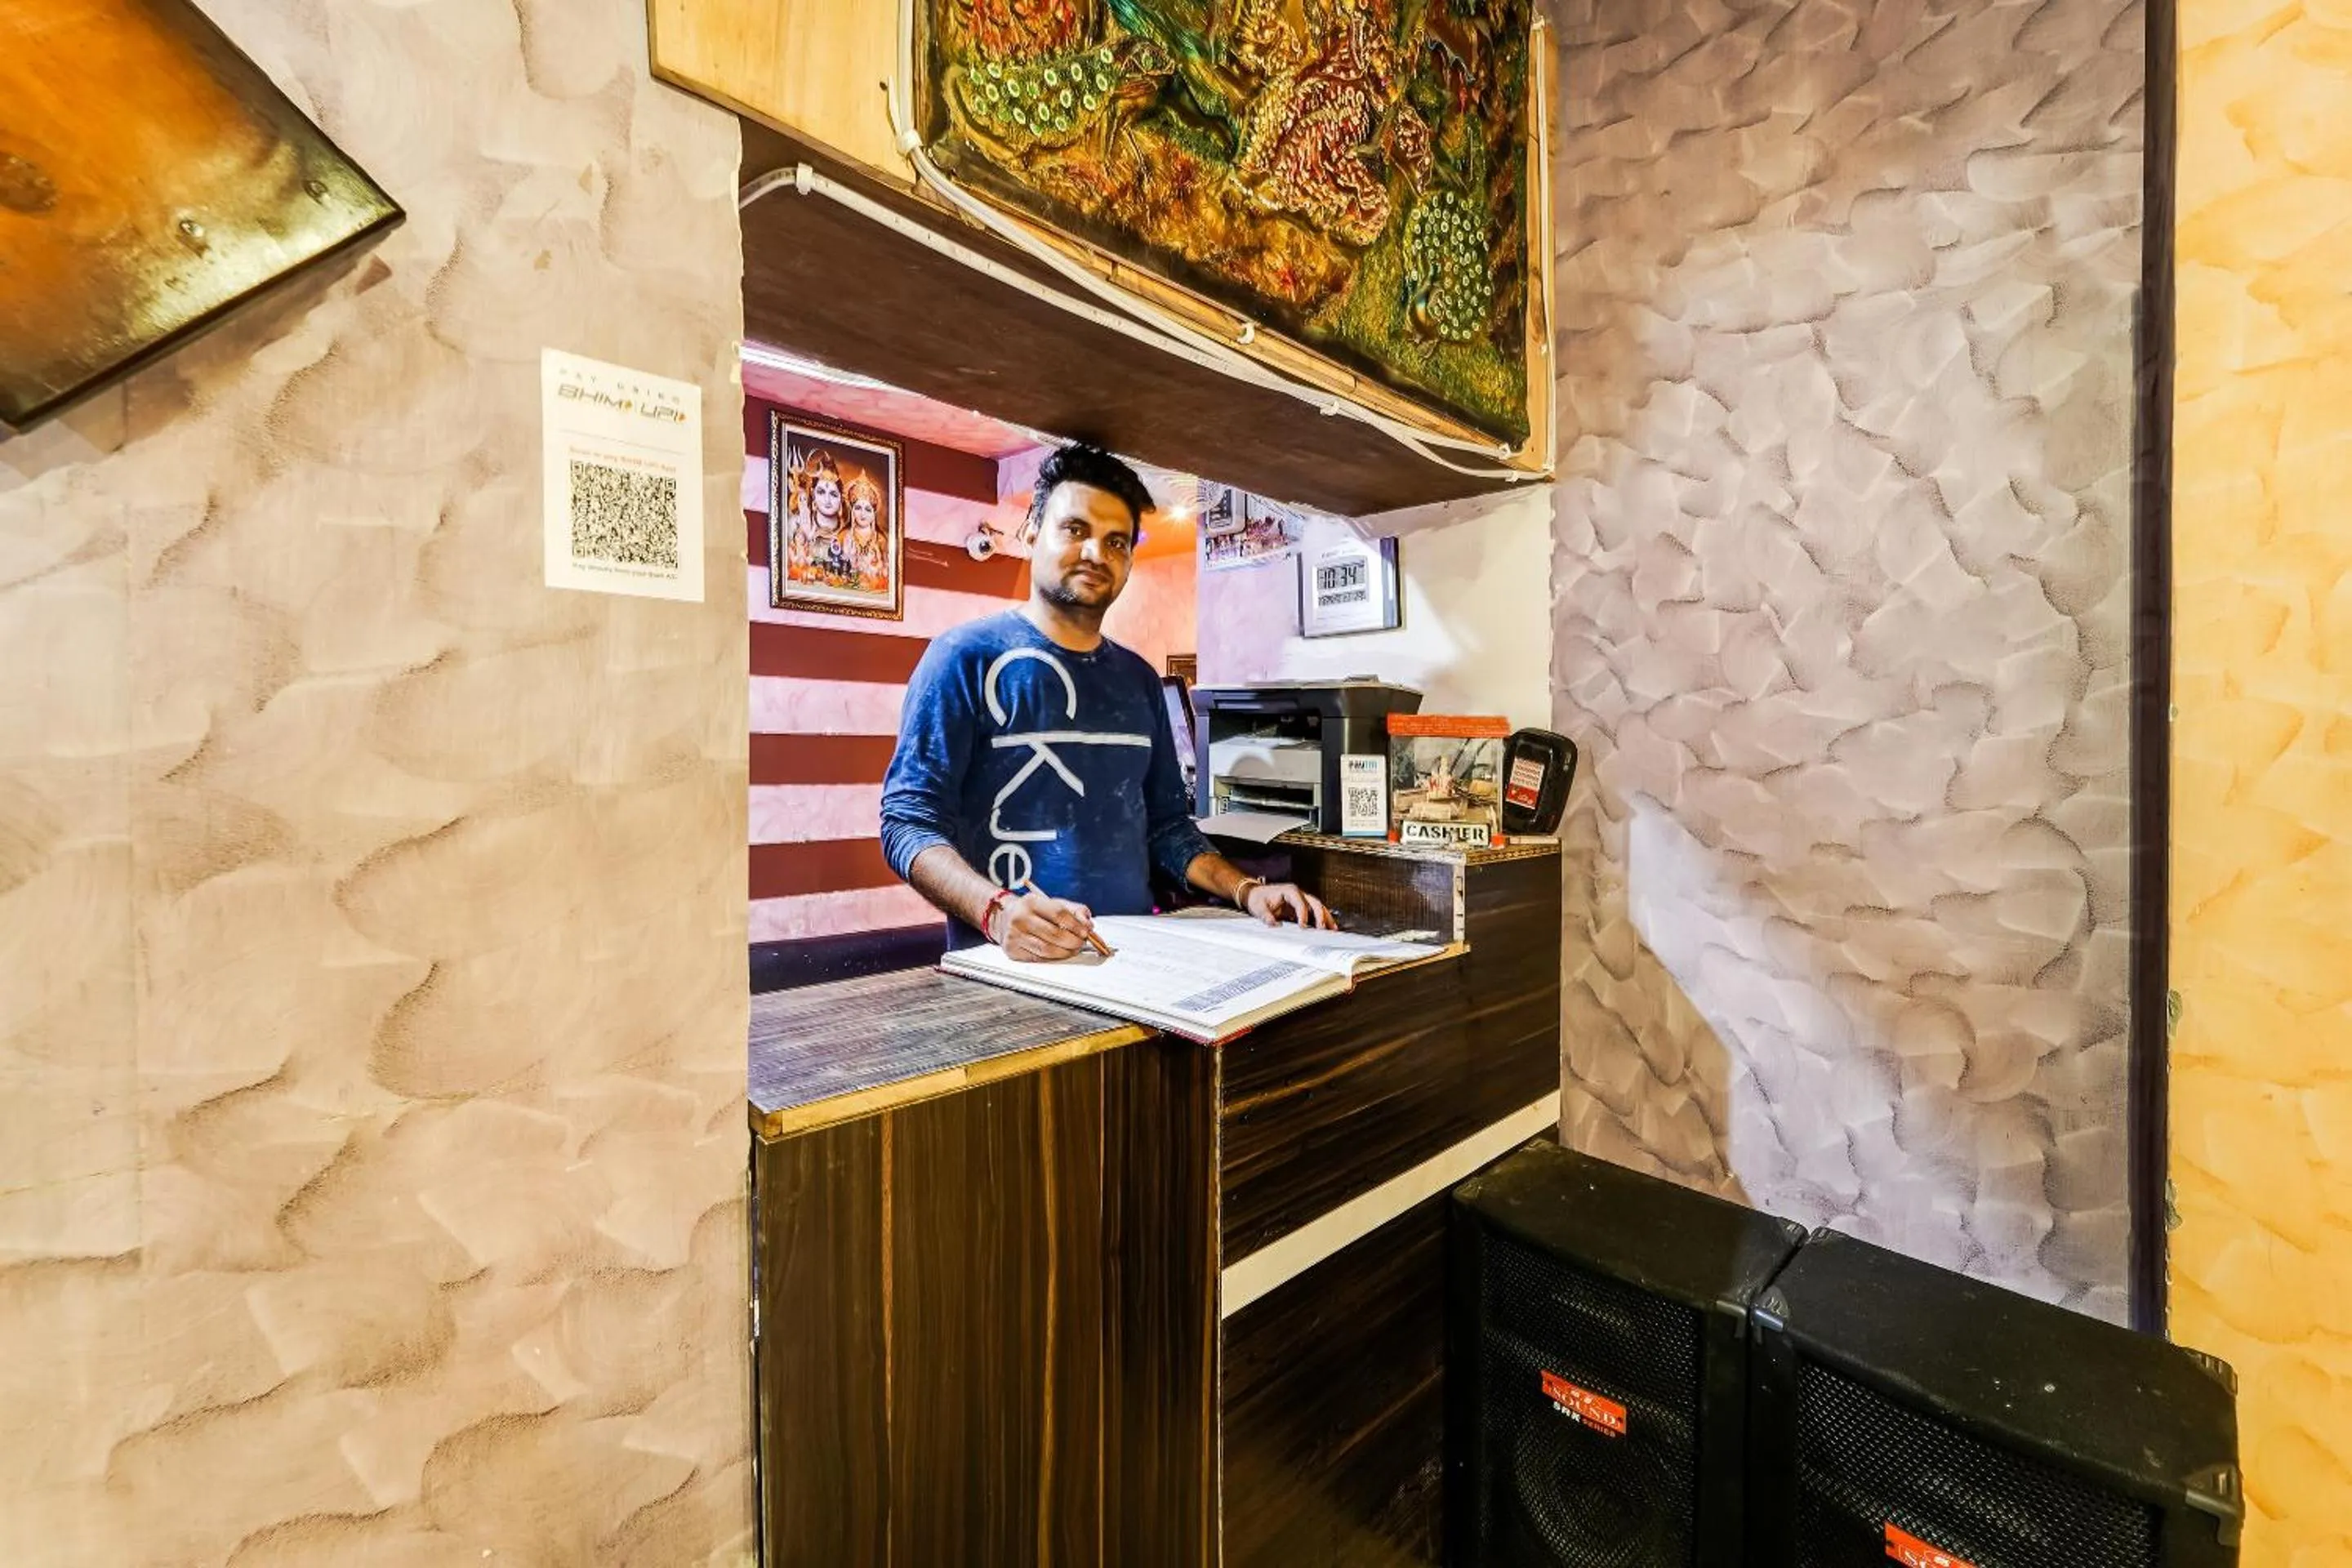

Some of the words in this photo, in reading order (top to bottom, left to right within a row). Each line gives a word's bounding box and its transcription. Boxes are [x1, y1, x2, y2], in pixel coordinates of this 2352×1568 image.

[558, 383, 623, 409] BHIM
[640, 403, 679, 422] UPI
[1406, 825, 1484, 842] CASHIER
